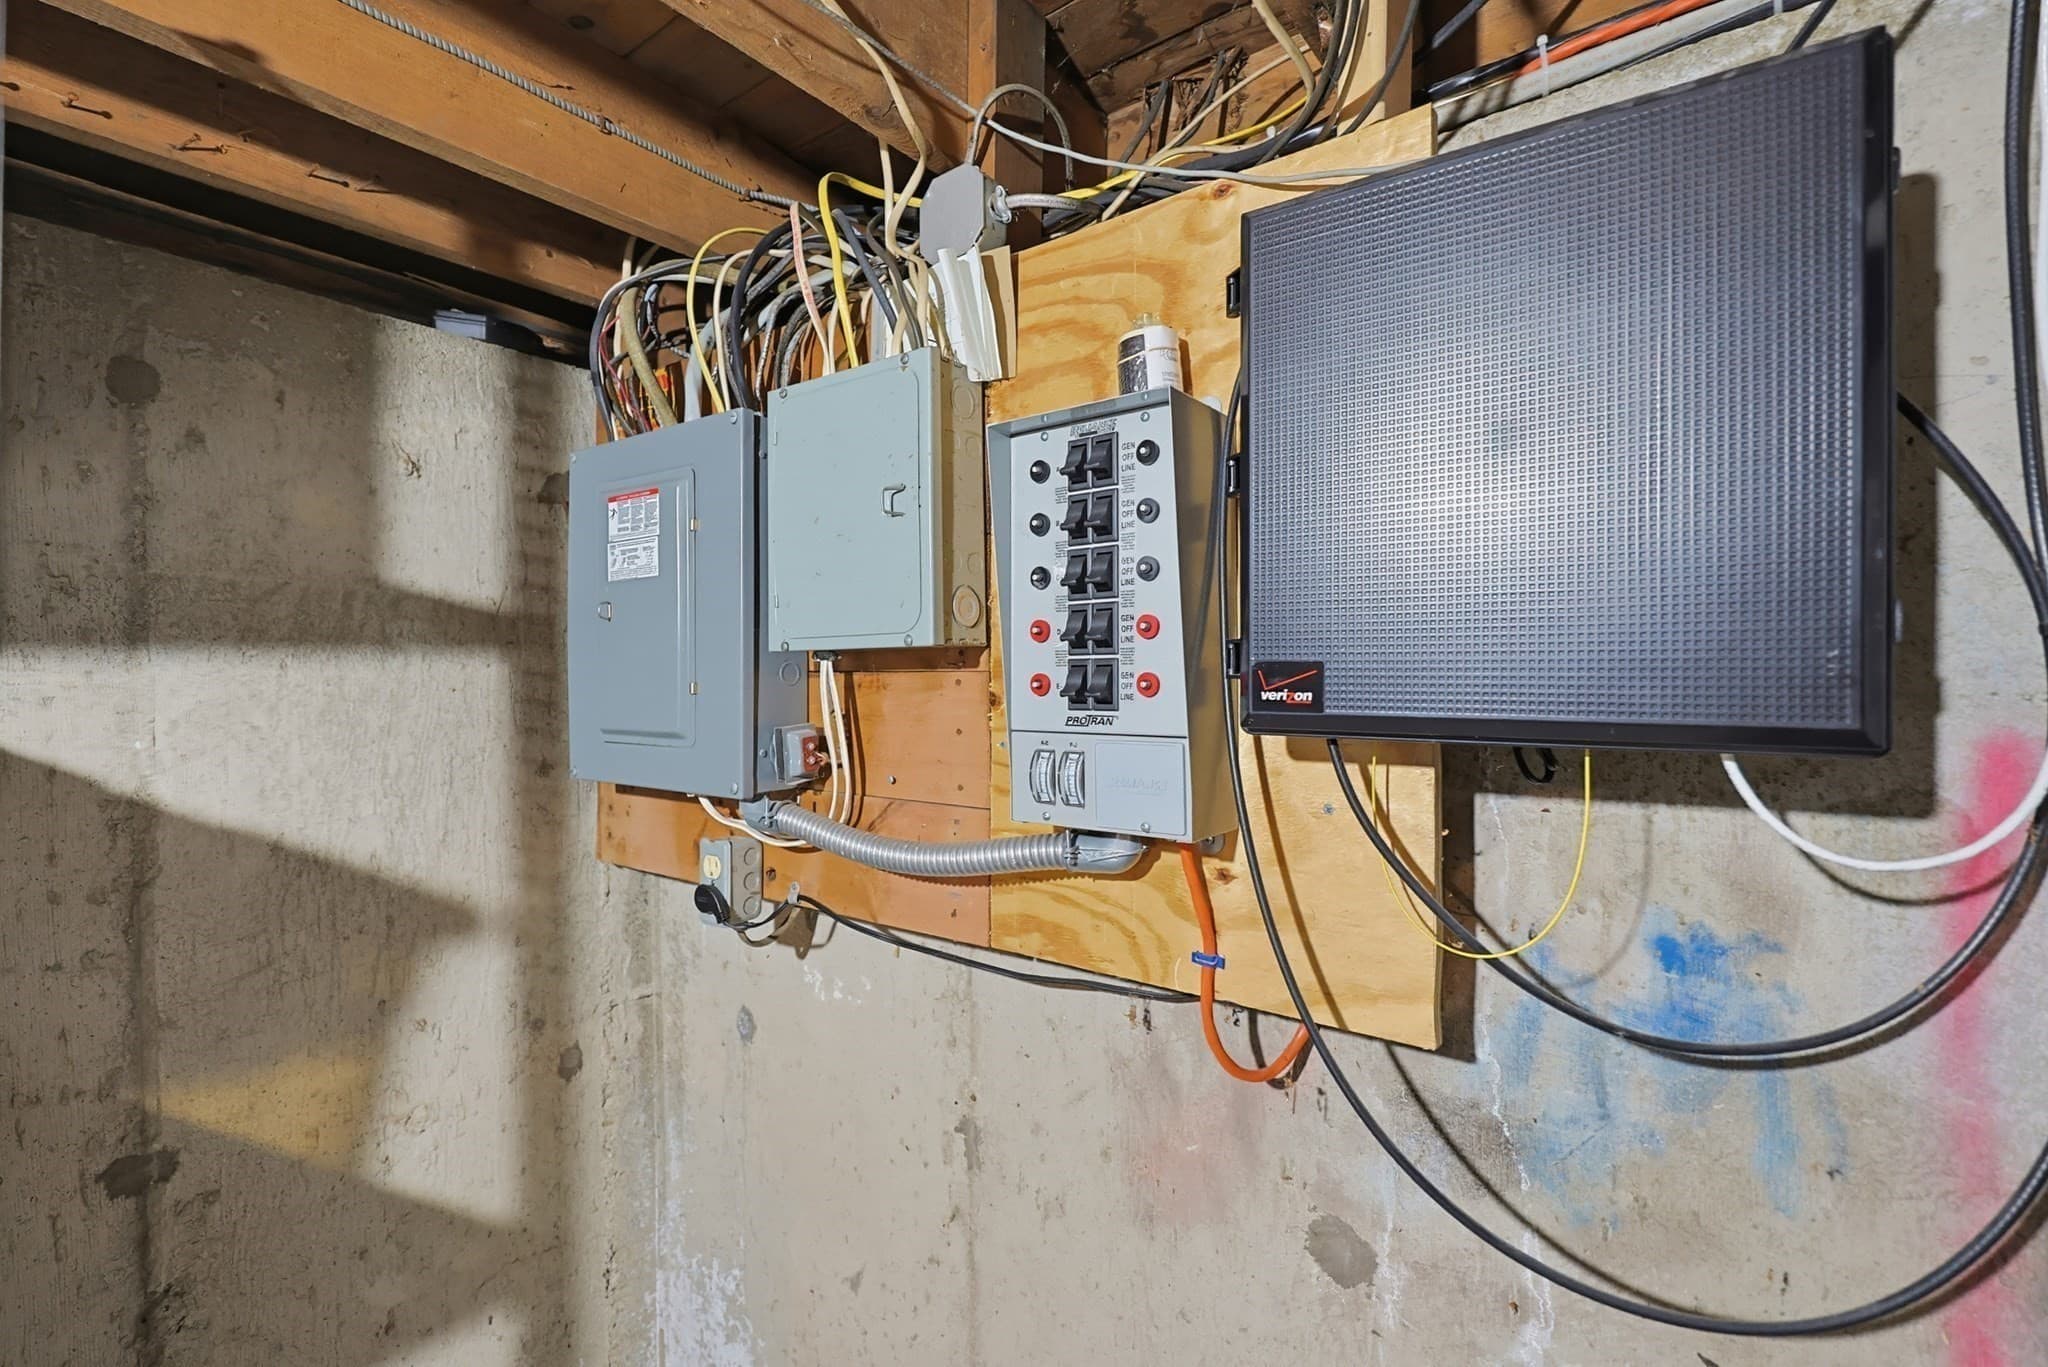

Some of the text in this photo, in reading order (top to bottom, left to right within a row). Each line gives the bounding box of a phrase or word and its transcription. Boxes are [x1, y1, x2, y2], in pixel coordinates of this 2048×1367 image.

[1121, 442, 1135, 451] GEN
[1122, 452, 1135, 461] OFF
[1121, 463, 1136, 472] LINE
[1121, 500, 1135, 509] GEN
[1122, 510, 1135, 518] OFF
[1121, 521, 1136, 529] LINE
[1121, 557, 1135, 565] GEN
[1121, 567, 1134, 576] OFF
[1120, 577, 1136, 586] LINE
[1120, 614, 1135, 622] GEN
[1121, 625, 1134, 633] OFF
[1120, 635, 1135, 643] LINE
[1120, 672, 1135, 680] GEN
[1121, 682, 1134, 690] OFF
[1120, 692, 1135, 701] LINE
[1260, 689, 1313, 704] verizon
[1065, 715, 1118, 727] PROTRAN
